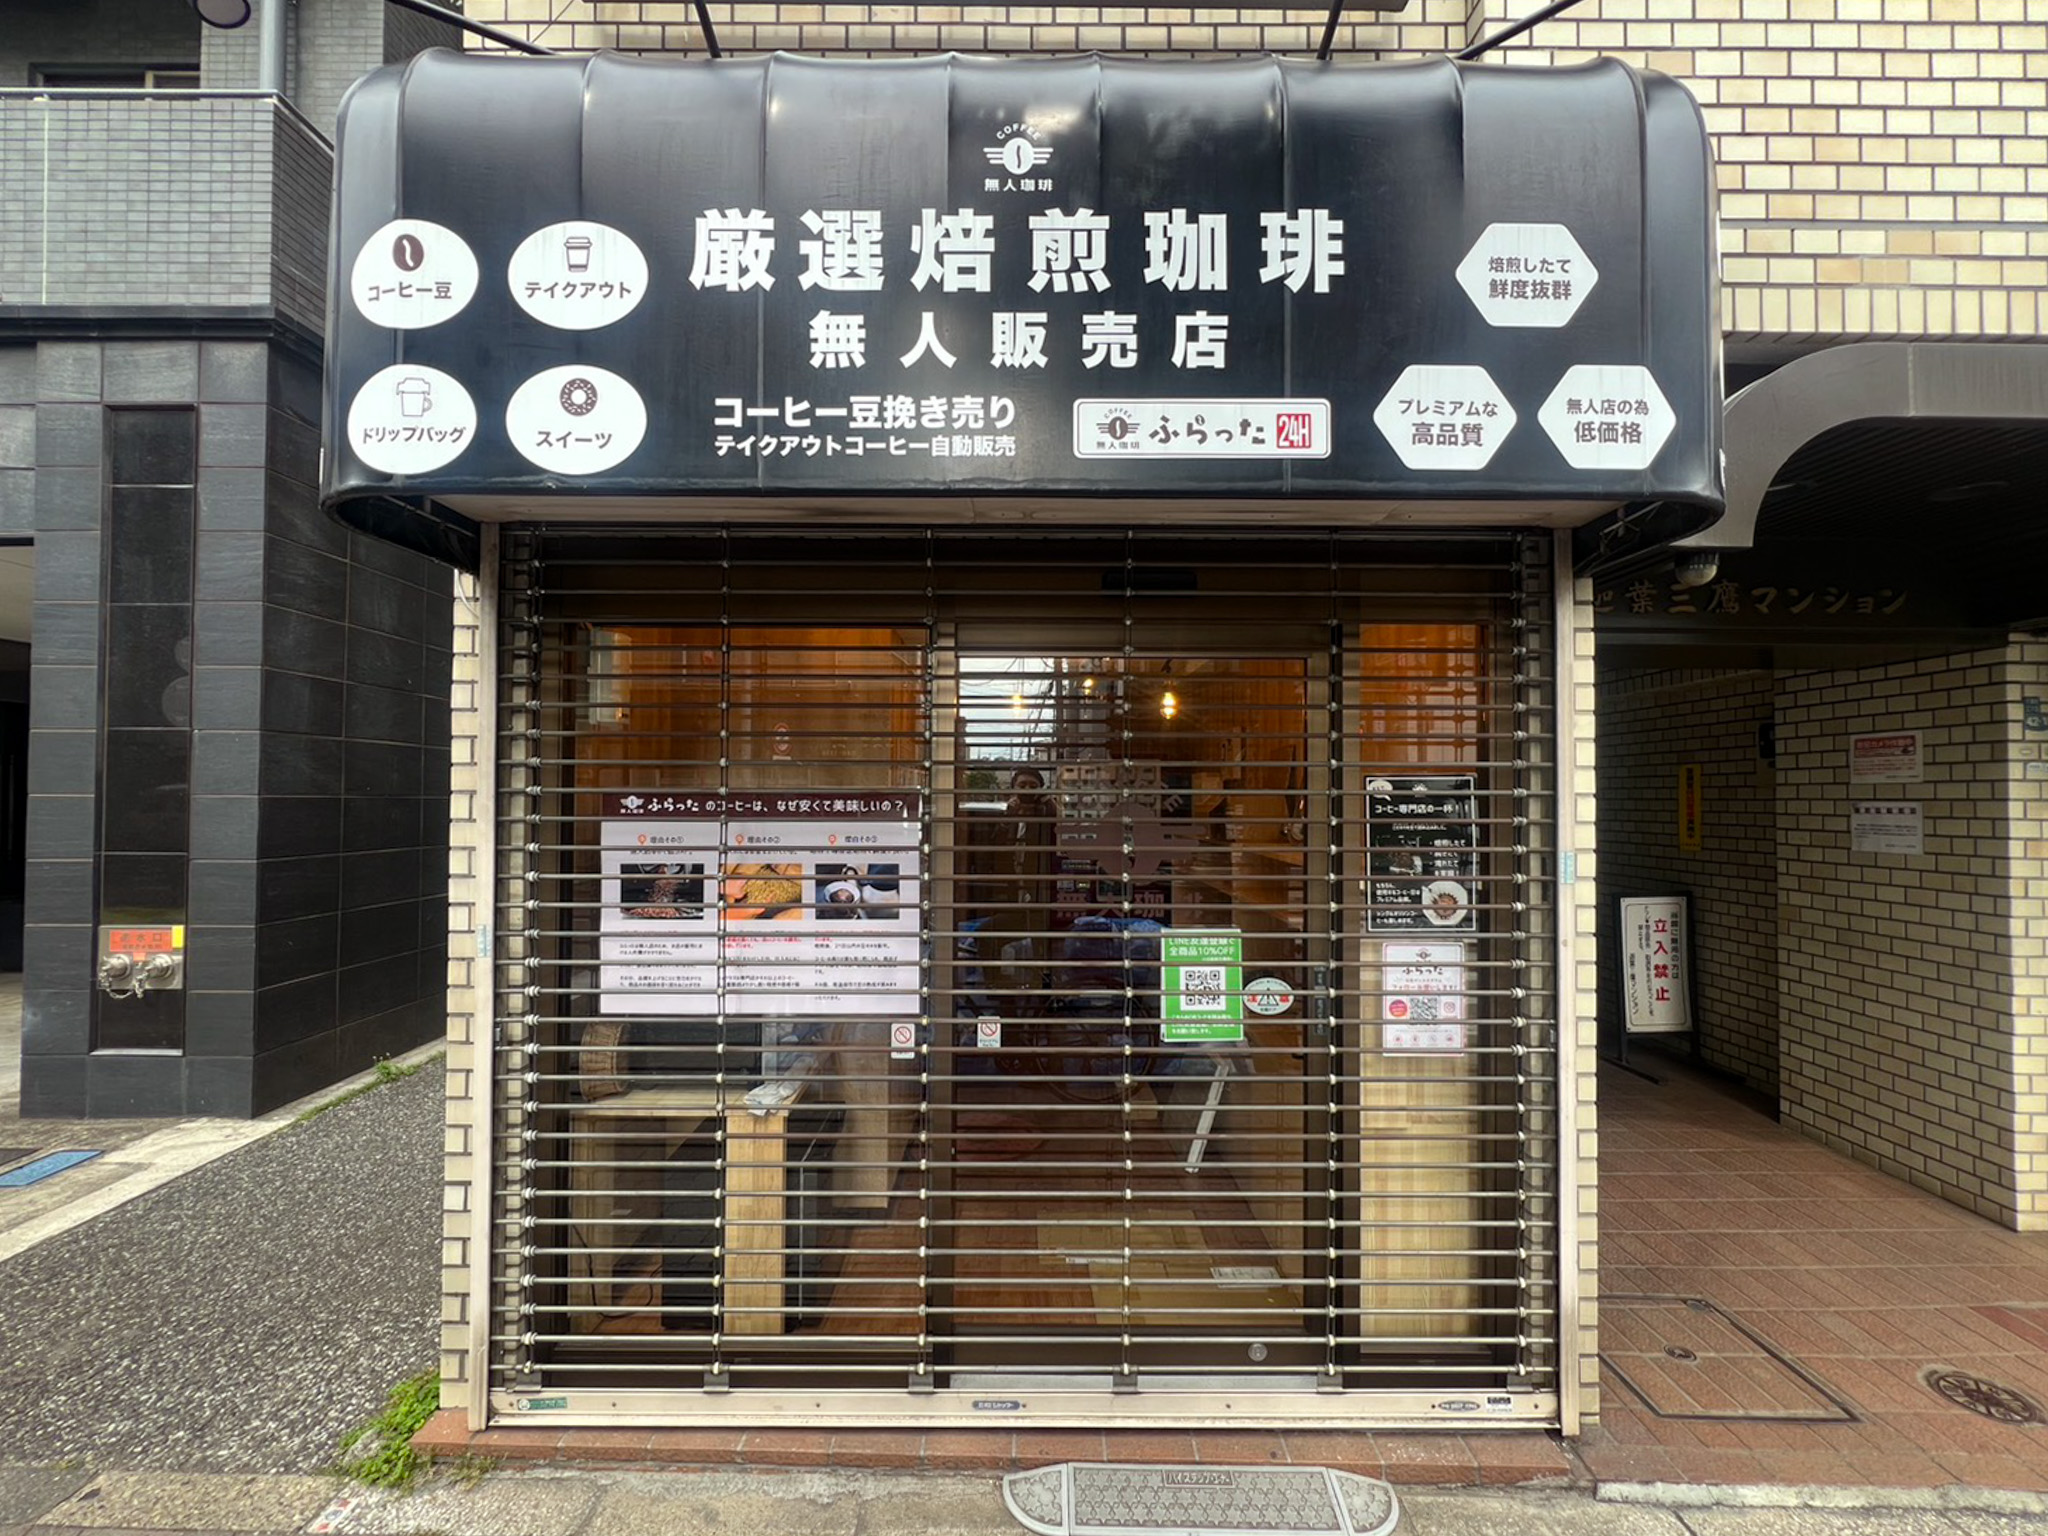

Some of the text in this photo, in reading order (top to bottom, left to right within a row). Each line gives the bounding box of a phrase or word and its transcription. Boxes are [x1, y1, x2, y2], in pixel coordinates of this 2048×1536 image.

[996, 122, 1042, 141] COFFEE
[984, 178, 1053, 192] 無人珈琲
[689, 207, 1344, 293] 厳選焙煎珈琲
[1488, 257, 1572, 275] 焙煎したて
[367, 281, 452, 301] コーヒー豆
[525, 280, 632, 300] テイクアウト
[1488, 278, 1572, 301] 鮮度抜群
[808, 309, 1229, 369] 無人販売店
[713, 395, 1016, 428] コーヒー豆挽き売り
[1398, 399, 1499, 418] プレミアムな
[1566, 397, 1650, 416] 無人店の為
[361, 425, 466, 446] ドリップバッグ
[536, 430, 613, 449] スイーツ
[1149, 413, 1312, 448] ふらった 24H
[1411, 422, 1484, 447] 高品質
[1574, 421, 1643, 445] 低価格
[714, 433, 1016, 457] テイクアウトコーヒー自動販売
[1653, 918, 1670, 1001] 立入禁止
